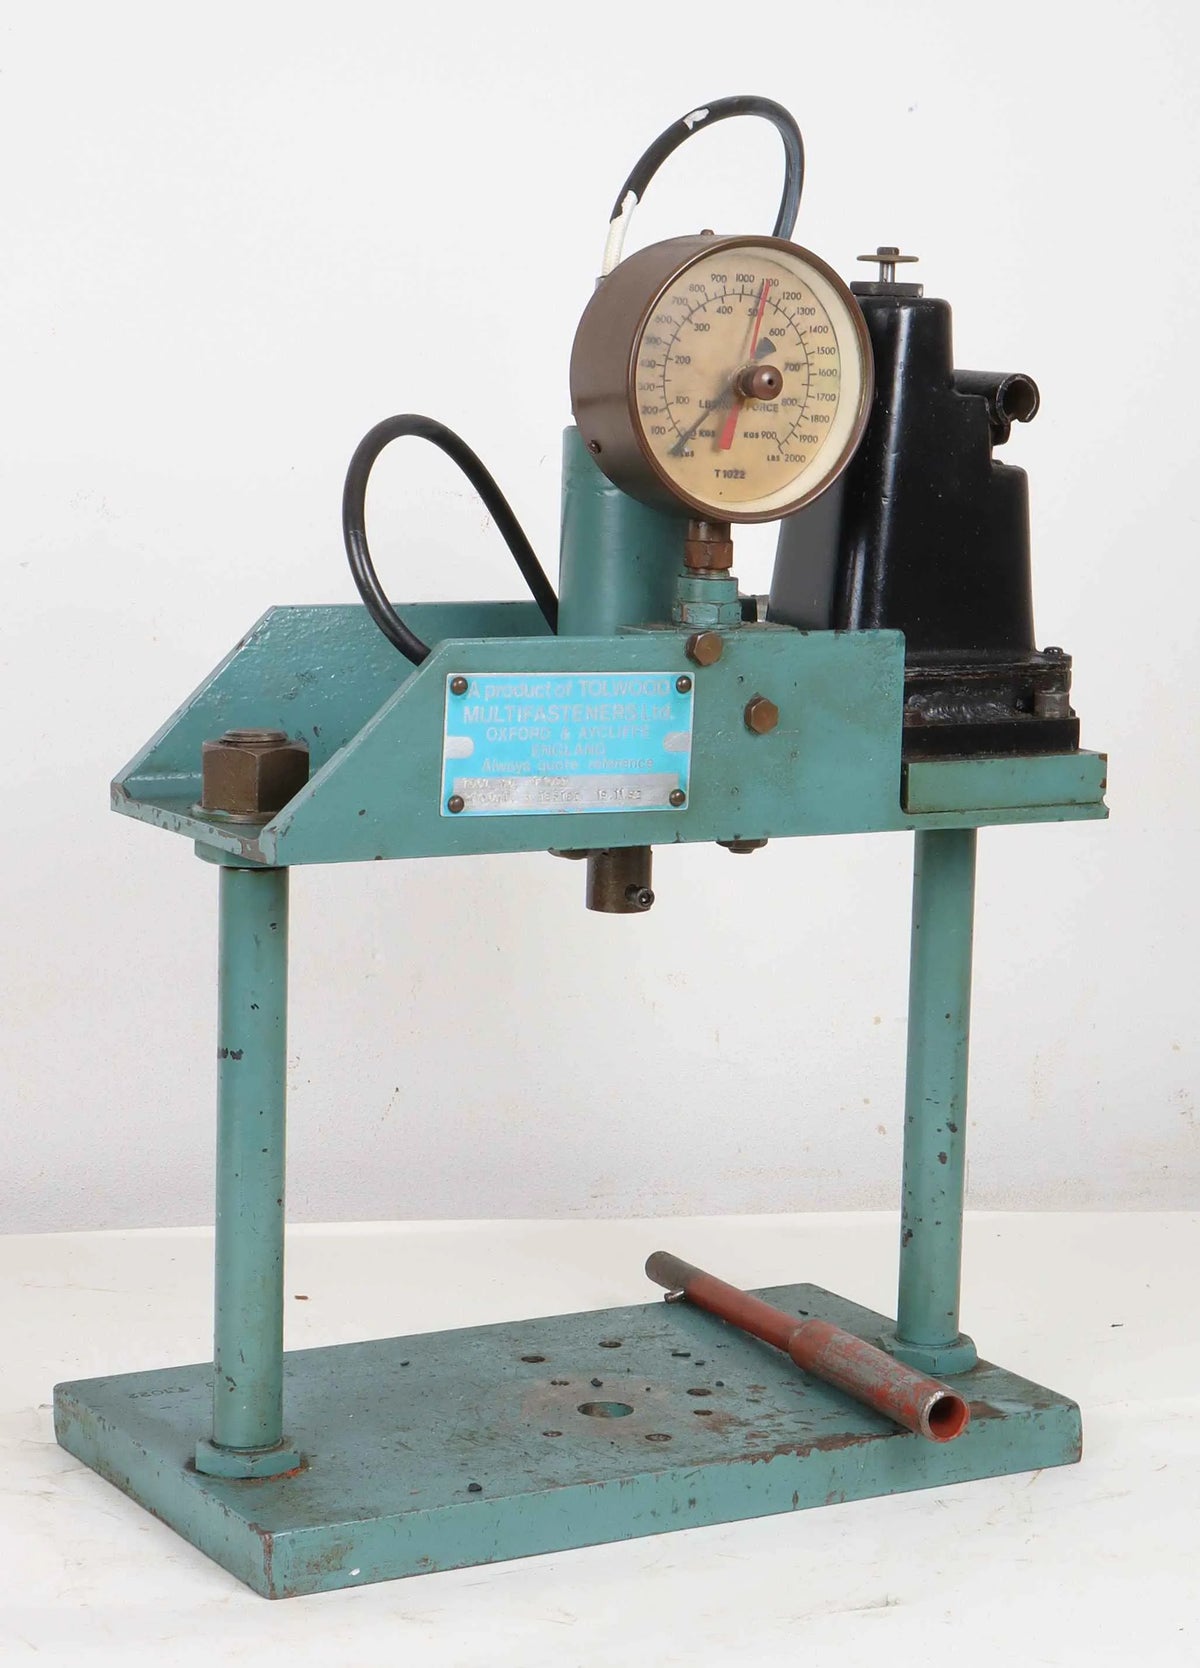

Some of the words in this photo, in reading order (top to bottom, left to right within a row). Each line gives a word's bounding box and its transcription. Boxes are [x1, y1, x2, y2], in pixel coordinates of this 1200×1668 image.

[711, 273, 727, 283] 900
[736, 274, 755, 283] 1000
[689, 284, 705, 293] 800
[782, 291, 802, 300] 1200
[671, 296, 688, 306] 700
[716, 306, 733, 315] 400
[748, 308, 760, 317] 50
[796, 307, 816, 316] 1300
[655, 315, 672, 324] 600
[694, 323, 710, 332] 300
[809, 325, 828, 334] 1400
[769, 328, 785, 337] 600
[817, 347, 836, 355] 1500
[675, 355, 691, 365] 200
[784, 363, 800, 372] 700
[818, 368, 838, 377] 1600
[676, 395, 690, 405] 100
[816, 392, 836, 402] 1700
[781, 398, 797, 407] 800
[642, 406, 658, 416] 200
[811, 415, 830, 424] 1800
[651, 427, 666, 436] 100
[743, 431, 759, 439] KGS
[761, 431, 777, 440] 900
[800, 435, 819, 444] 1900
[784, 454, 806, 463] 2000
[468, 681, 480, 698] A
[485, 680, 551, 701] product
[554, 681, 573, 697] of
[580, 679, 671, 698] TOLWOOD
[463, 703, 637, 724] MULTIFASTENERS
[486, 725, 552, 743] OXFORD
[482, 759, 532, 774] Always
